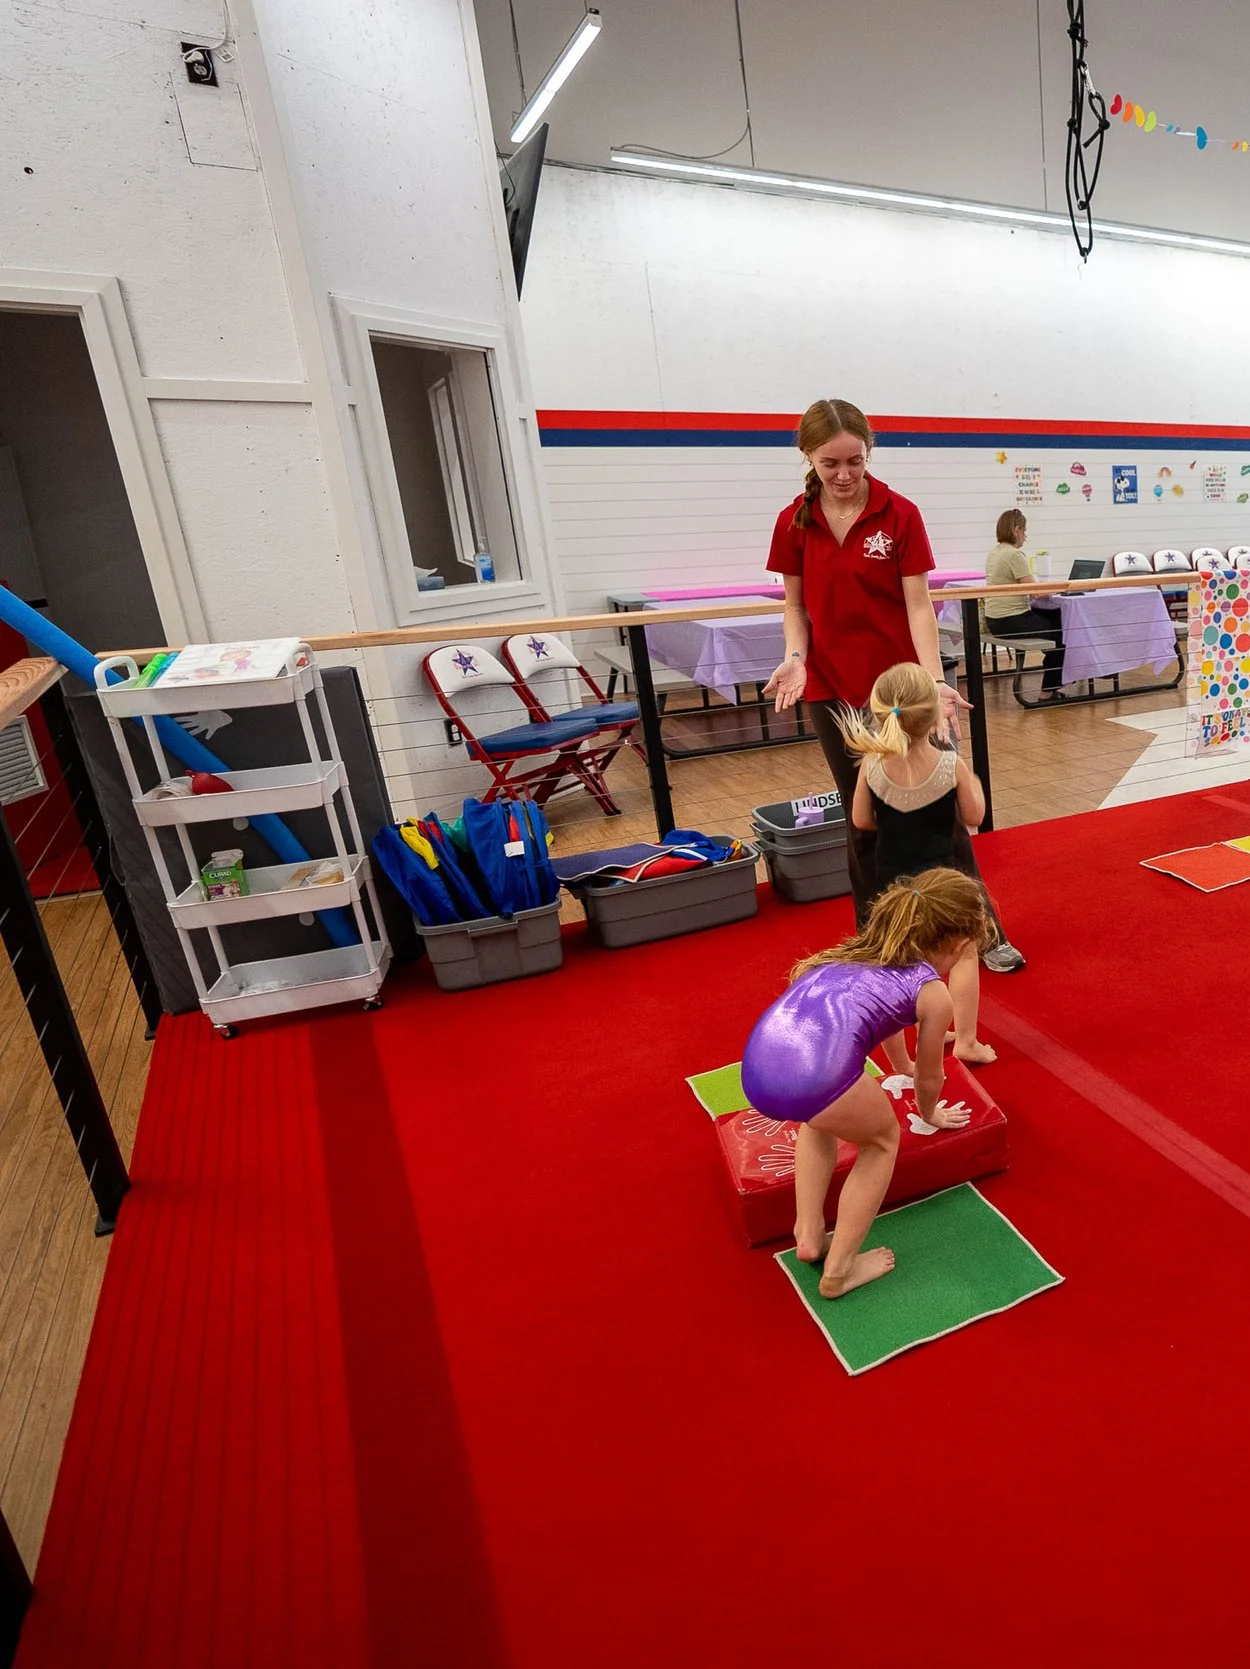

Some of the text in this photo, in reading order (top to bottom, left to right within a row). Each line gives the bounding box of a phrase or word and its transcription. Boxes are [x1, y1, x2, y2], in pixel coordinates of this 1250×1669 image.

[1223, 709, 1247, 721] OKAY
[1202, 717, 1246, 739] TO FEEL
[209, 870, 232, 879] CURAD
